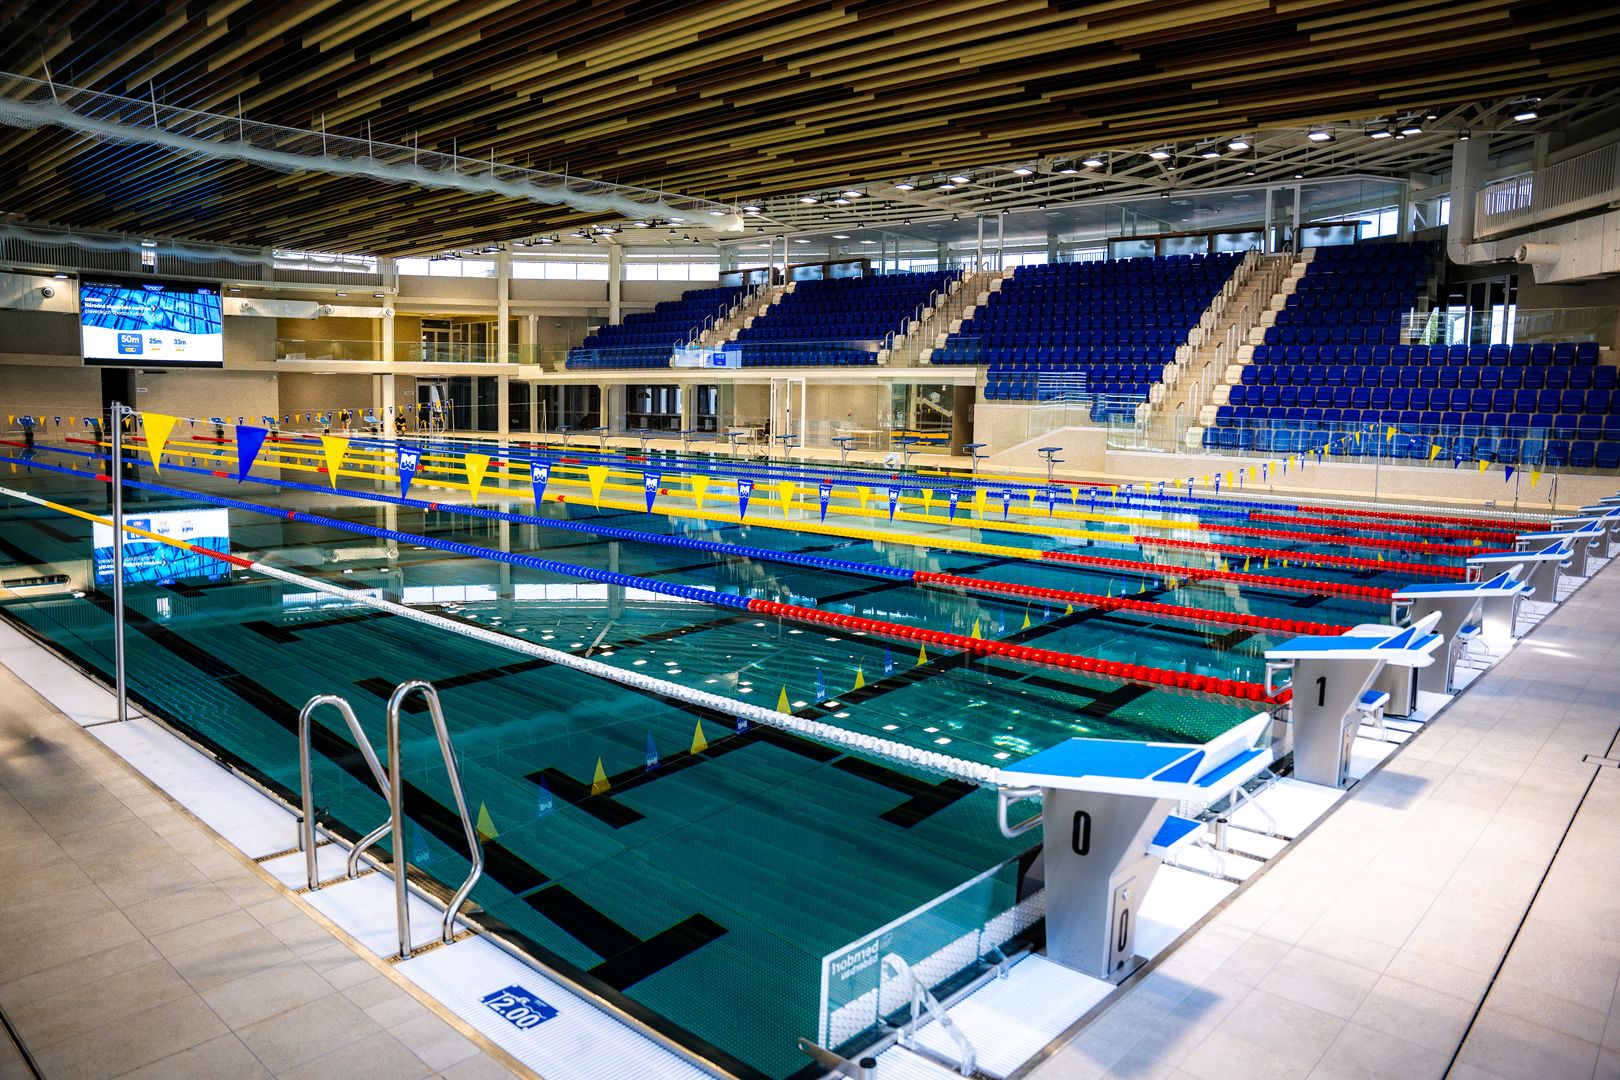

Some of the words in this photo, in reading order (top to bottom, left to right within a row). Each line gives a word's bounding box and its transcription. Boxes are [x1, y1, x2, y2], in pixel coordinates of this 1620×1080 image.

[121, 334, 140, 343] 50m
[174, 338, 187, 346] 33m
[1316, 676, 1327, 707] 1
[1072, 810, 1092, 856] 0
[1118, 908, 1129, 953] 0
[488, 997, 540, 1028] 2.00
